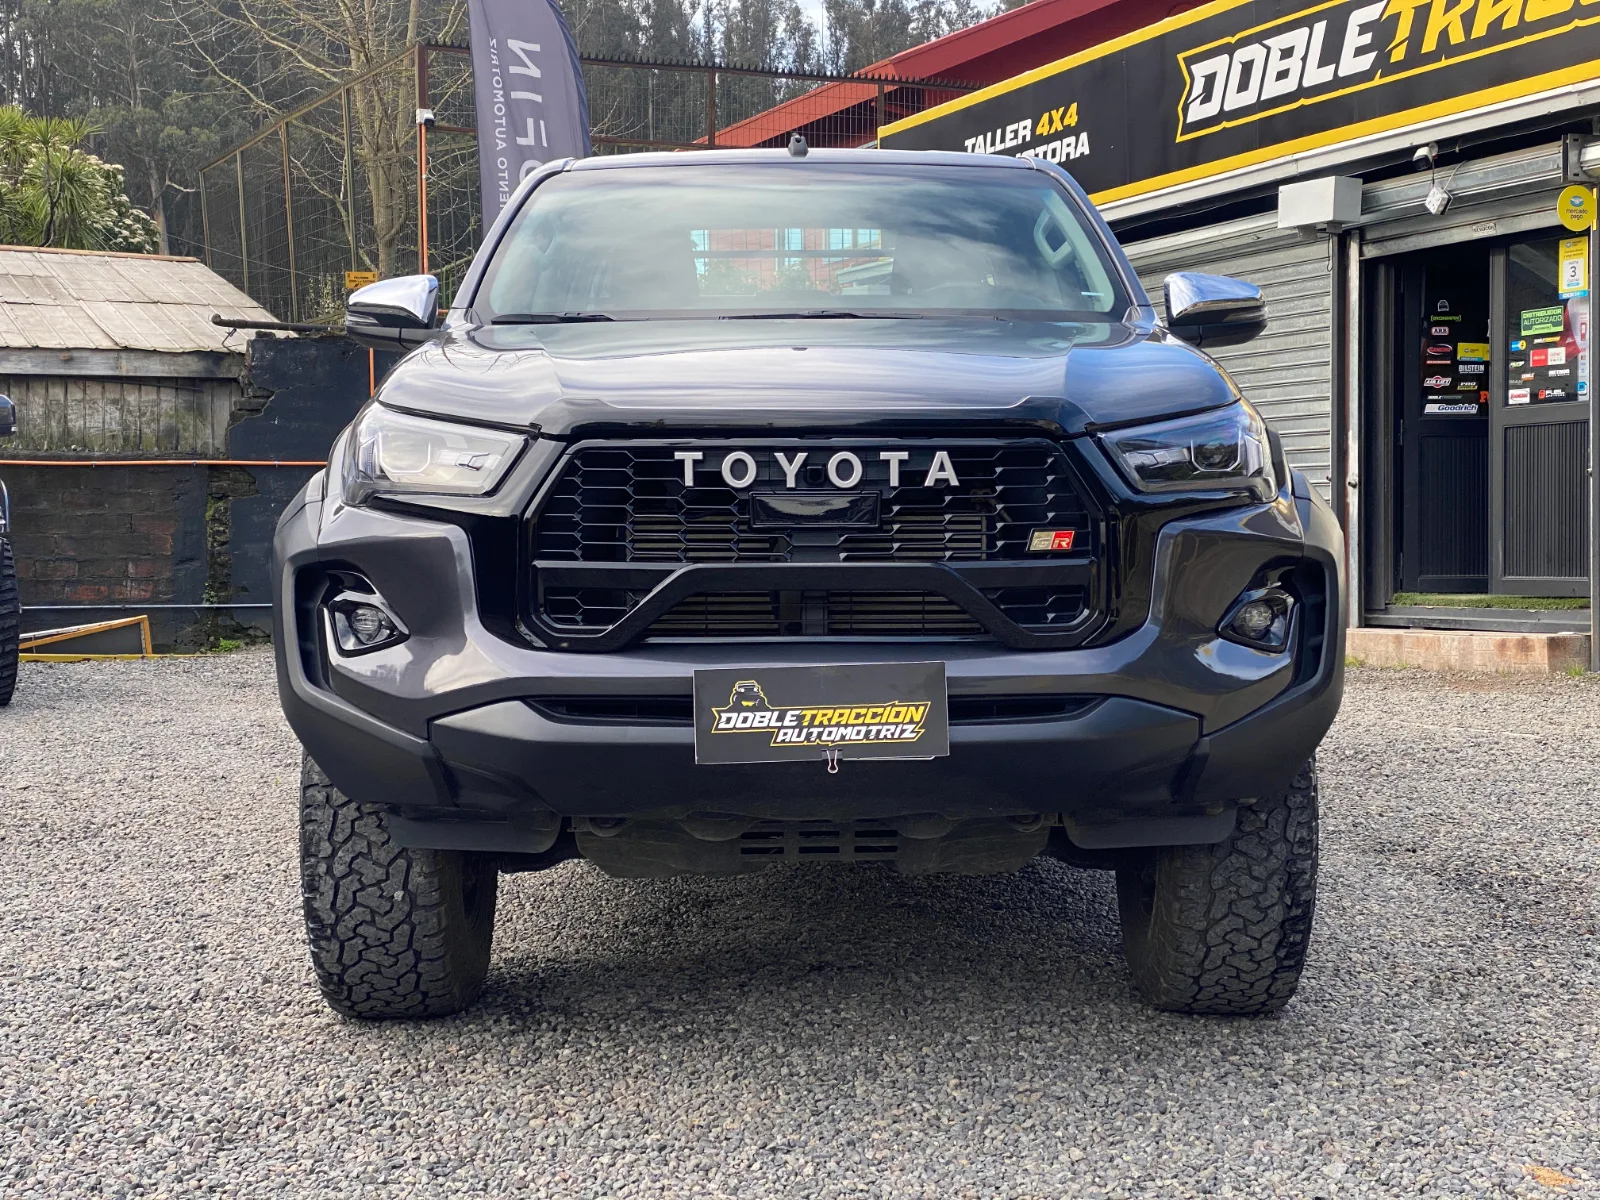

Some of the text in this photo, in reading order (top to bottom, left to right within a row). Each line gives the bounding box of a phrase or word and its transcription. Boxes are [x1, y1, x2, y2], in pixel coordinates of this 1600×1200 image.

[964, 102, 1078, 154] TALLER 4X4
[1570, 265, 1577, 277] 3
[1523, 308, 1562, 319] DISTRIBUIDOR
[1524, 315, 1562, 325] AUTORIZADO
[674, 450, 960, 489] TOYOTA
[1034, 537, 1070, 548] GR
[776, 724, 917, 743] AUTOMOTRIZ
